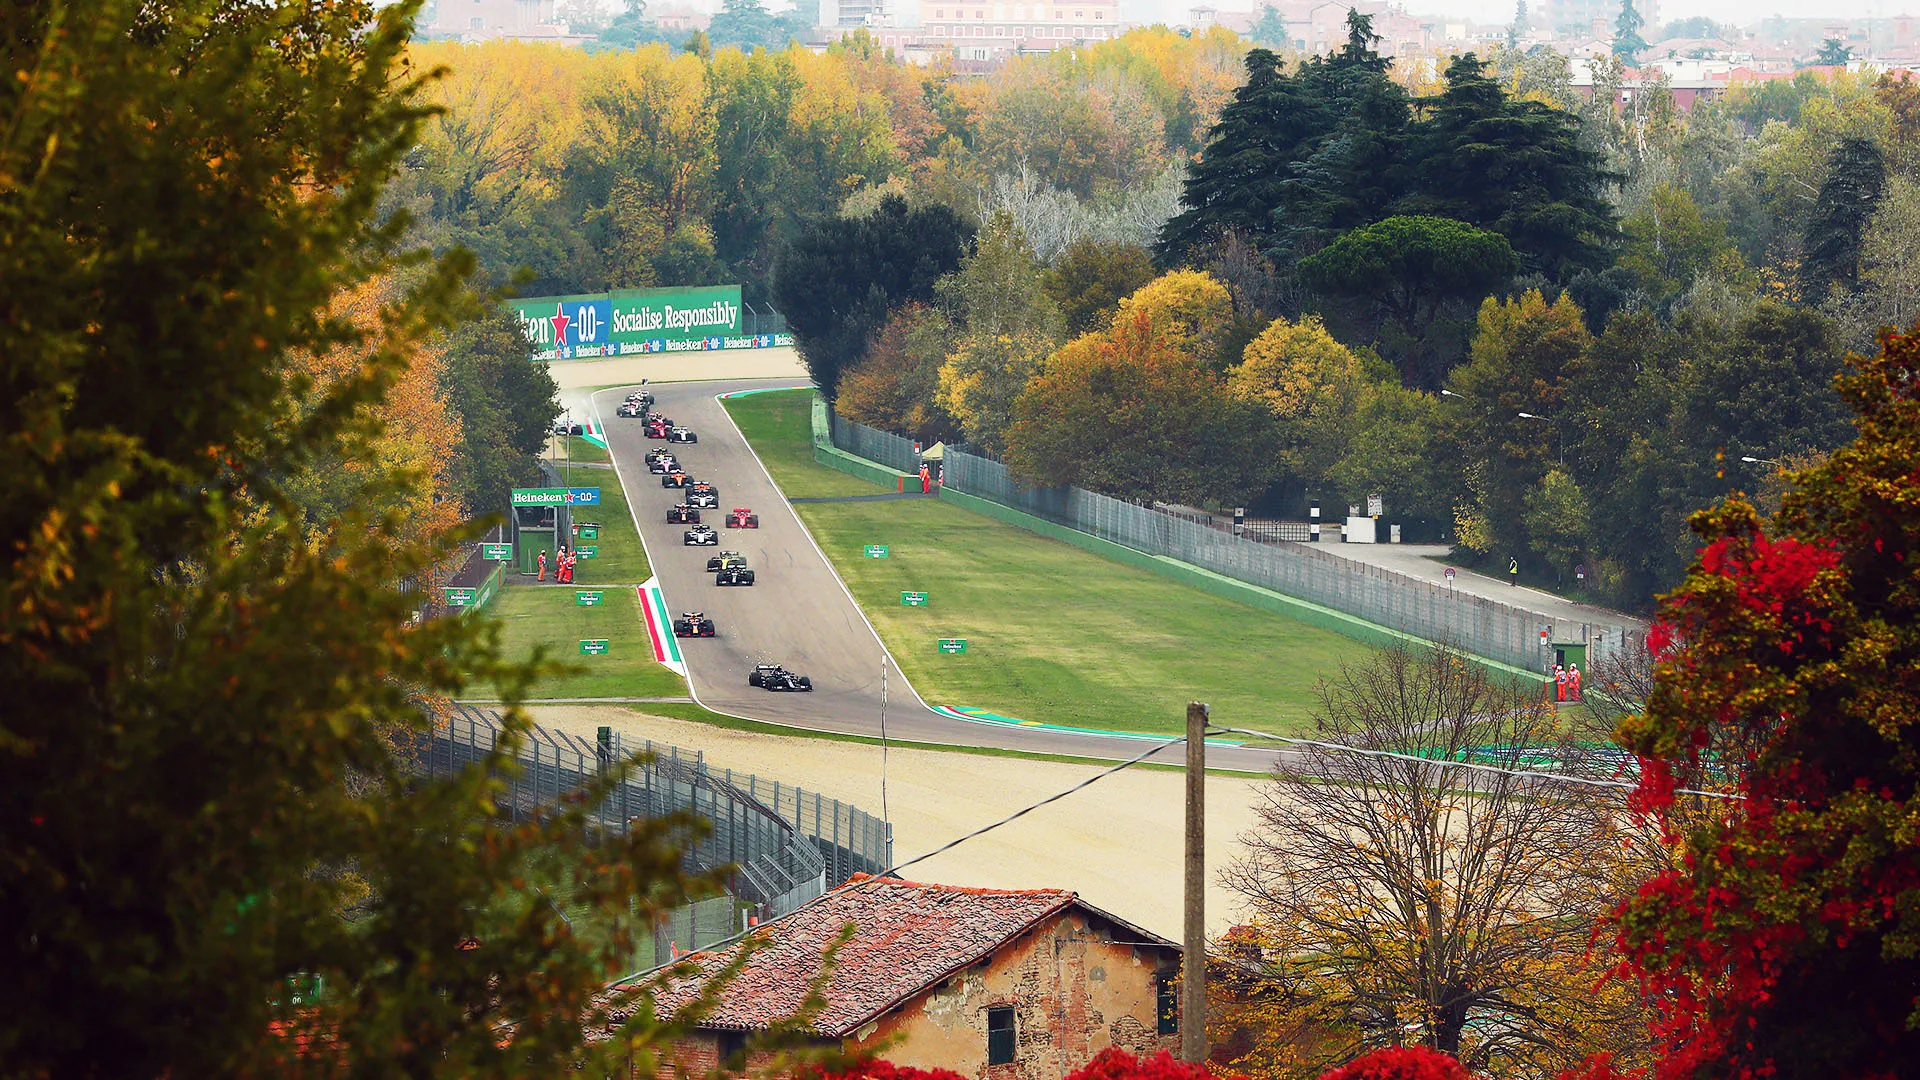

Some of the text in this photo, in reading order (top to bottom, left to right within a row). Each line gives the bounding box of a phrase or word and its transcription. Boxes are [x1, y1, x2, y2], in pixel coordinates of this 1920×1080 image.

[613, 301, 737, 333] Socialise Responsibly
[666, 339, 702, 351] Heineken
[724, 337, 751, 349] Heineken
[514, 493, 562, 502] Heineken
